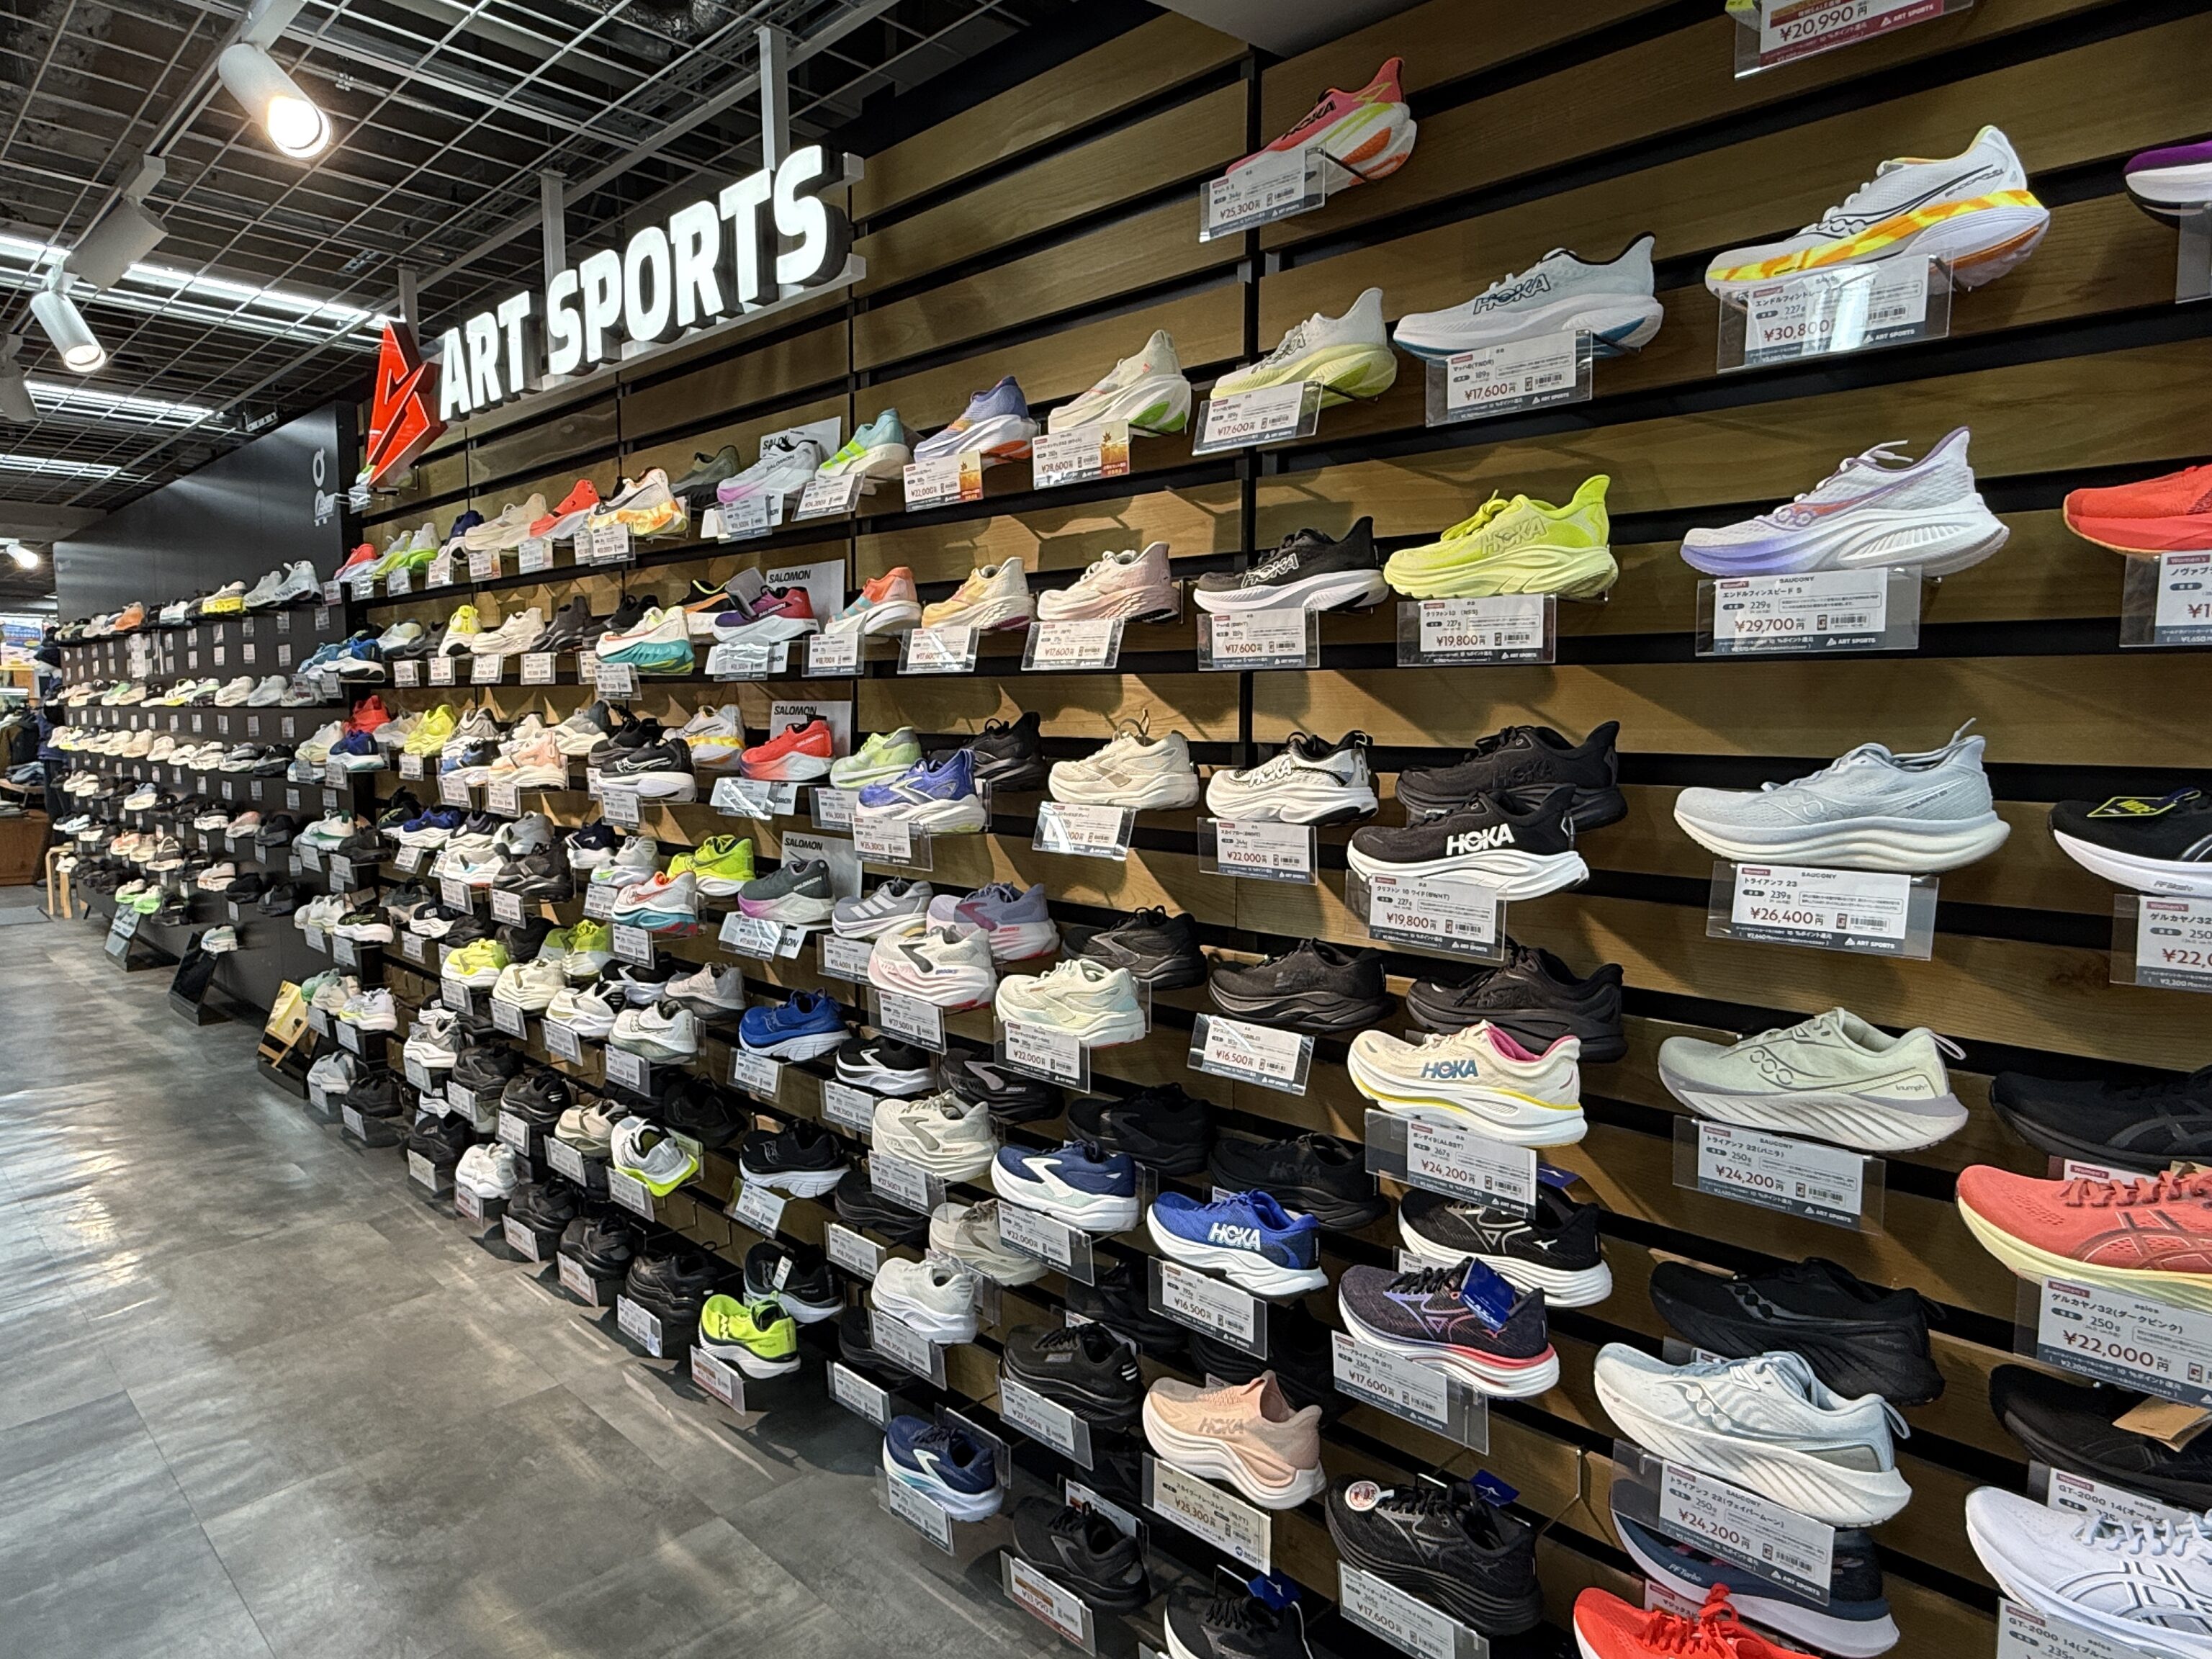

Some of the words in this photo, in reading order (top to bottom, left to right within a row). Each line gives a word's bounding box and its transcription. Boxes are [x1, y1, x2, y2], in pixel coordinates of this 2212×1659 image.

[440, 291, 531, 421] ART
[547, 145, 828, 375] SPORTS
[1473, 273, 1552, 315] HOKA
[1480, 516, 1547, 556] HOKA
[769, 569, 811, 584] SALOMON
[1779, 575, 1815, 585] SAUCONY
[2188, 603, 2212, 619] ¥1
[774, 706, 817, 717] SALOMON
[784, 837, 823, 851] SALOMON
[1446, 823, 1515, 856] HOKA
[1802, 871, 1837, 880] SAUCONY
[1870, 941, 1895, 950] SPORTS
[1421, 1059, 1479, 1079] HOKA
[1208, 1222, 1262, 1251] HOKA
